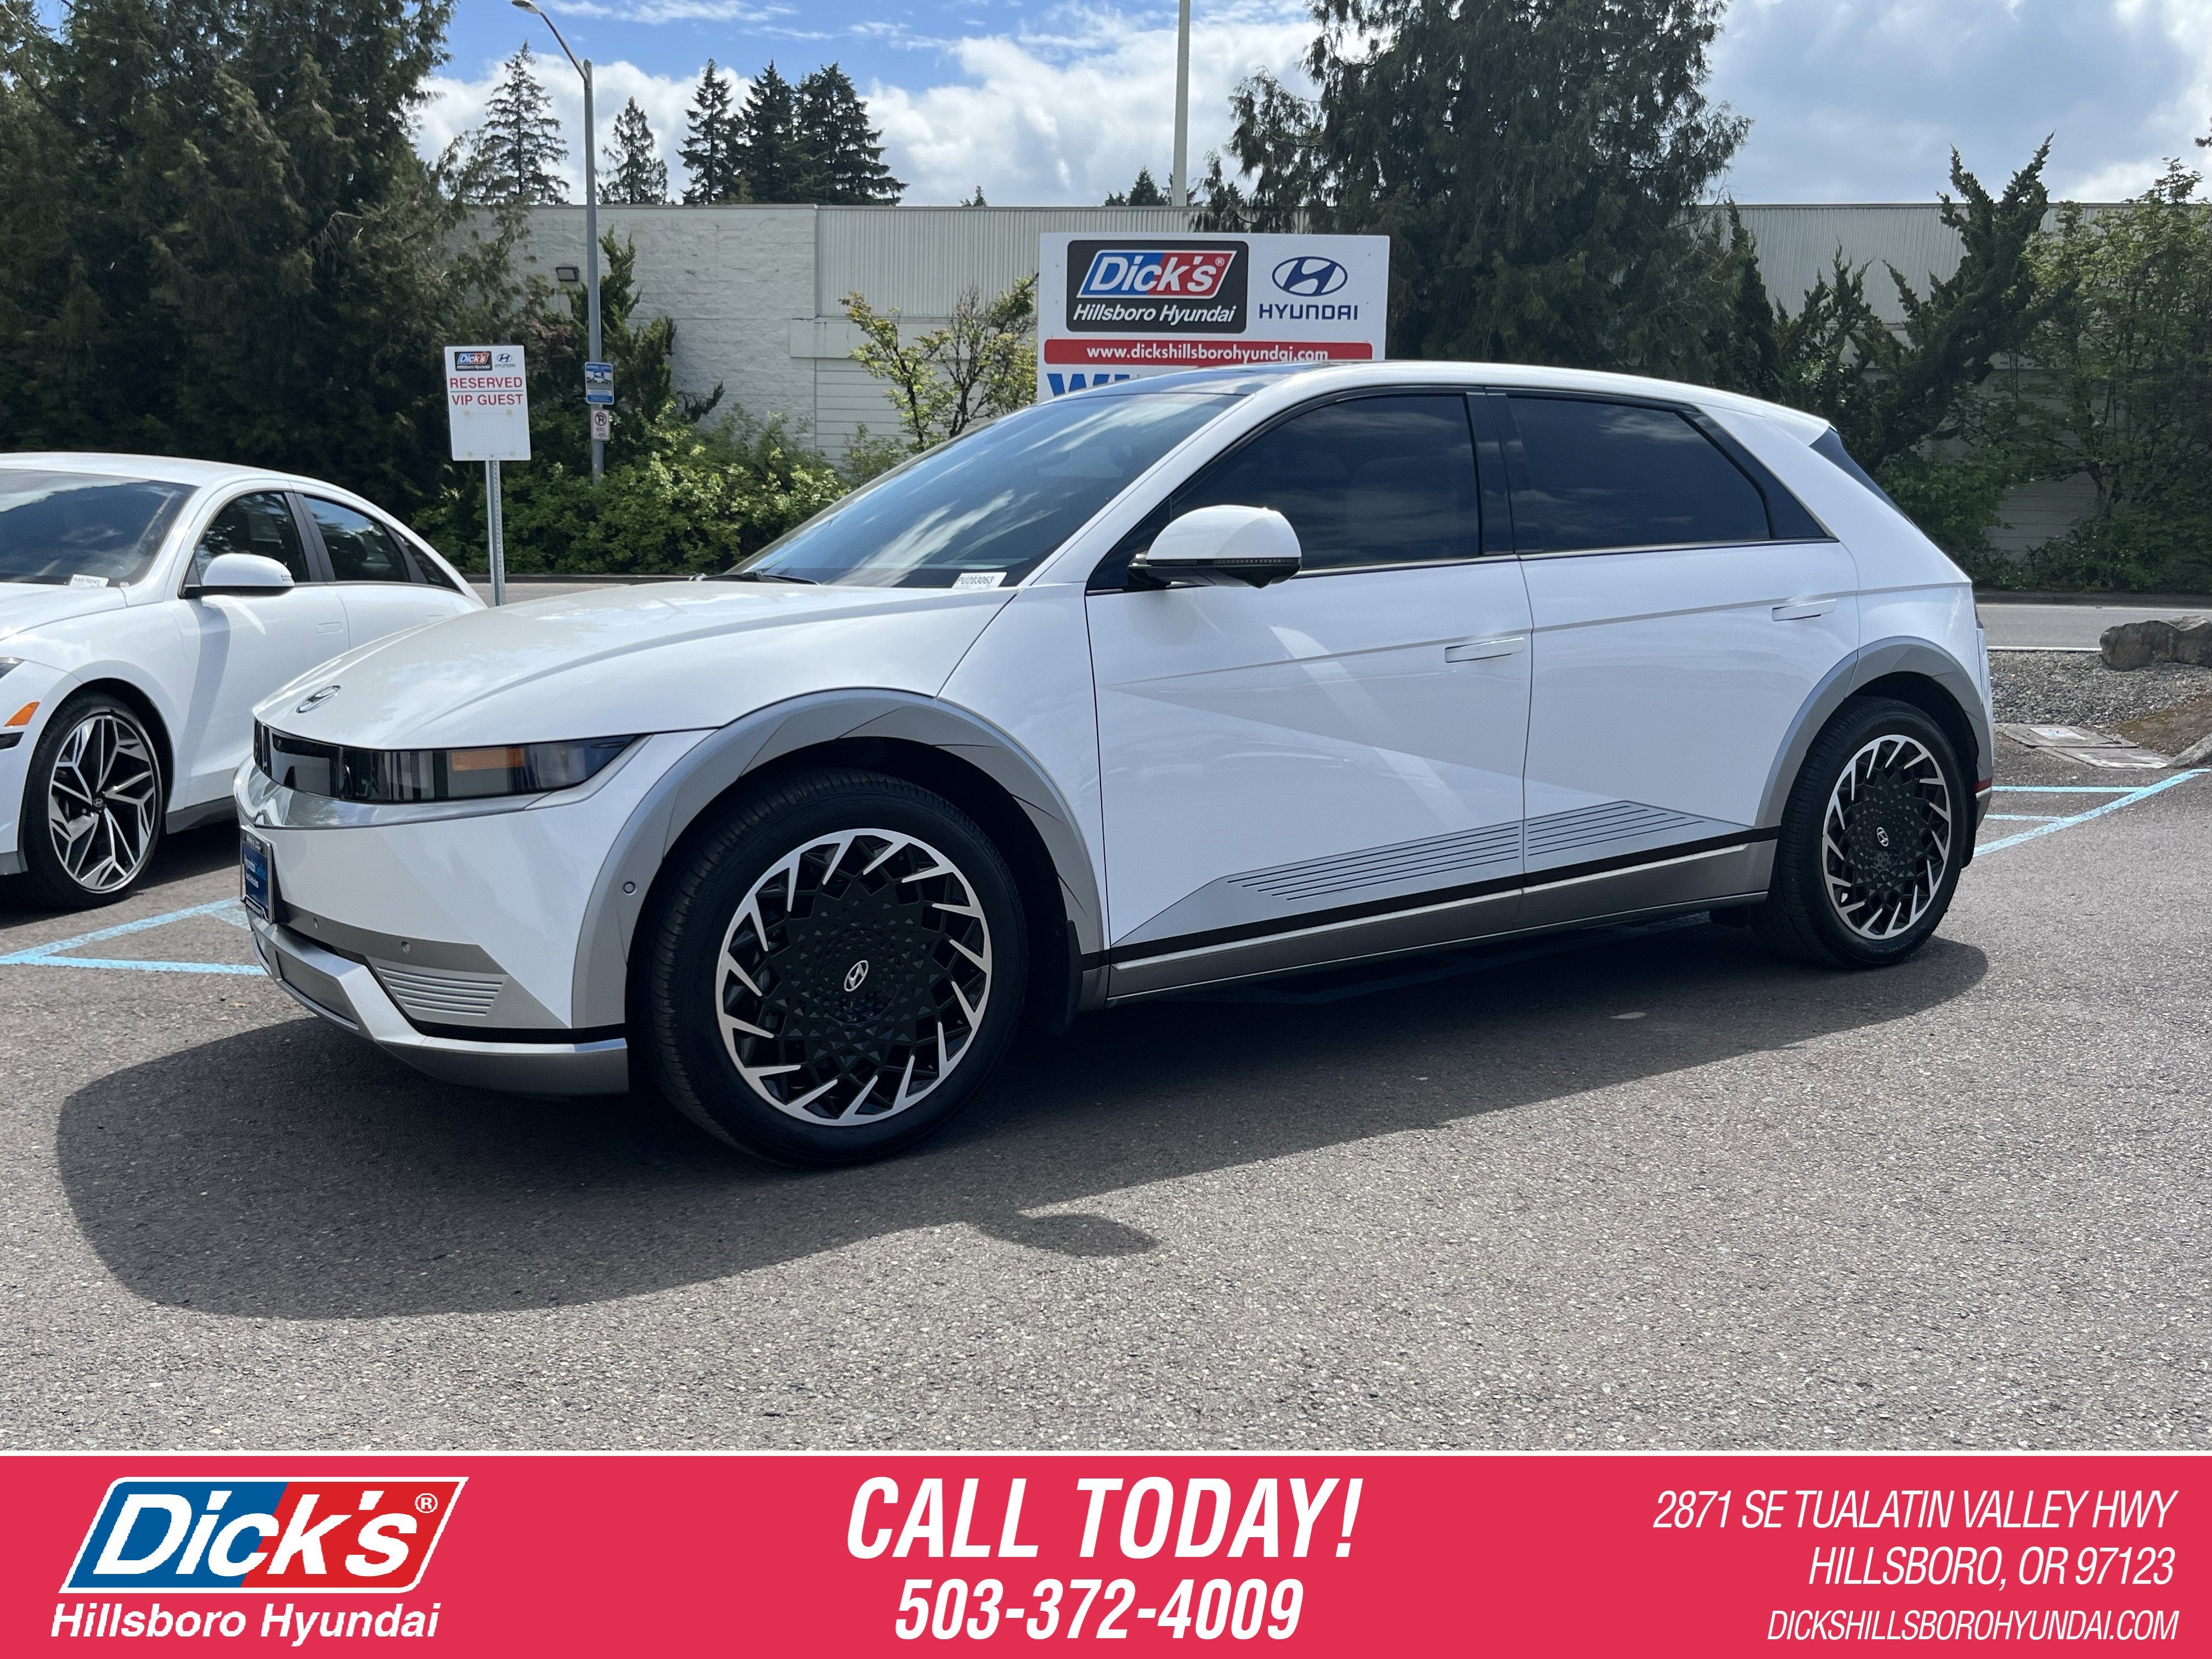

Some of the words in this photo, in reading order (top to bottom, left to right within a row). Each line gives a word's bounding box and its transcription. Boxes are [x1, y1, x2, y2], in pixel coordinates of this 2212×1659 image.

[1090, 255, 1217, 292] Dick's
[1073, 303, 1156, 321] Hillsboro
[1159, 304, 1237, 326] Hyundai
[1259, 303, 1358, 320] HYUNDAI
[1086, 343, 1328, 364] www.dickshillsborohyundai.com
[450, 377, 523, 388] RESERVED
[452, 394, 473, 405] VIP
[477, 394, 523, 405] GUEST
